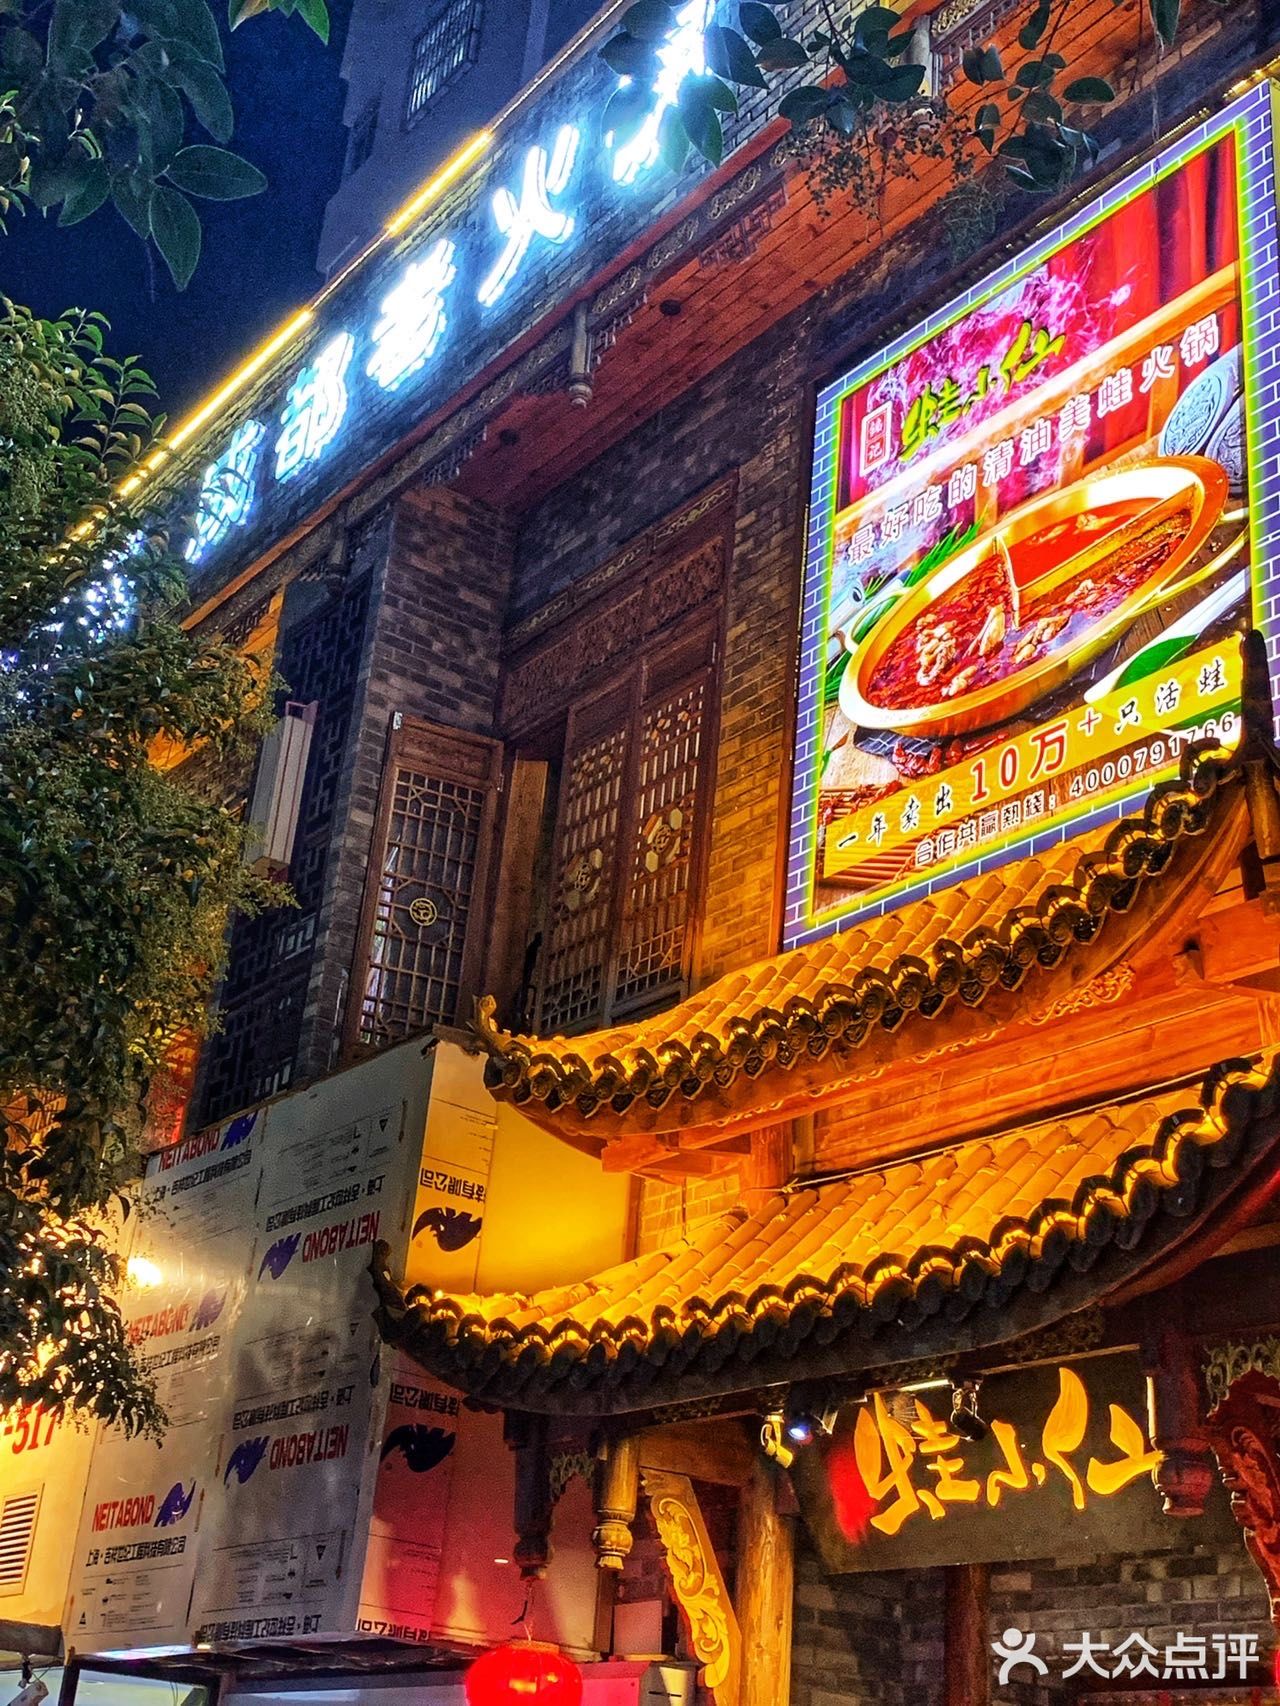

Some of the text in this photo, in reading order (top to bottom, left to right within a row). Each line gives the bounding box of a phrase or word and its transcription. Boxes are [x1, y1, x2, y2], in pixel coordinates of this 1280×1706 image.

[847, 313, 1220, 567] 最好吃的清油美蛙火锅
[302, 1210, 381, 1263] NEITABOND
[269, 1424, 350, 1470] NEITABOND
[92, 1494, 156, 1533] NEITABOND
